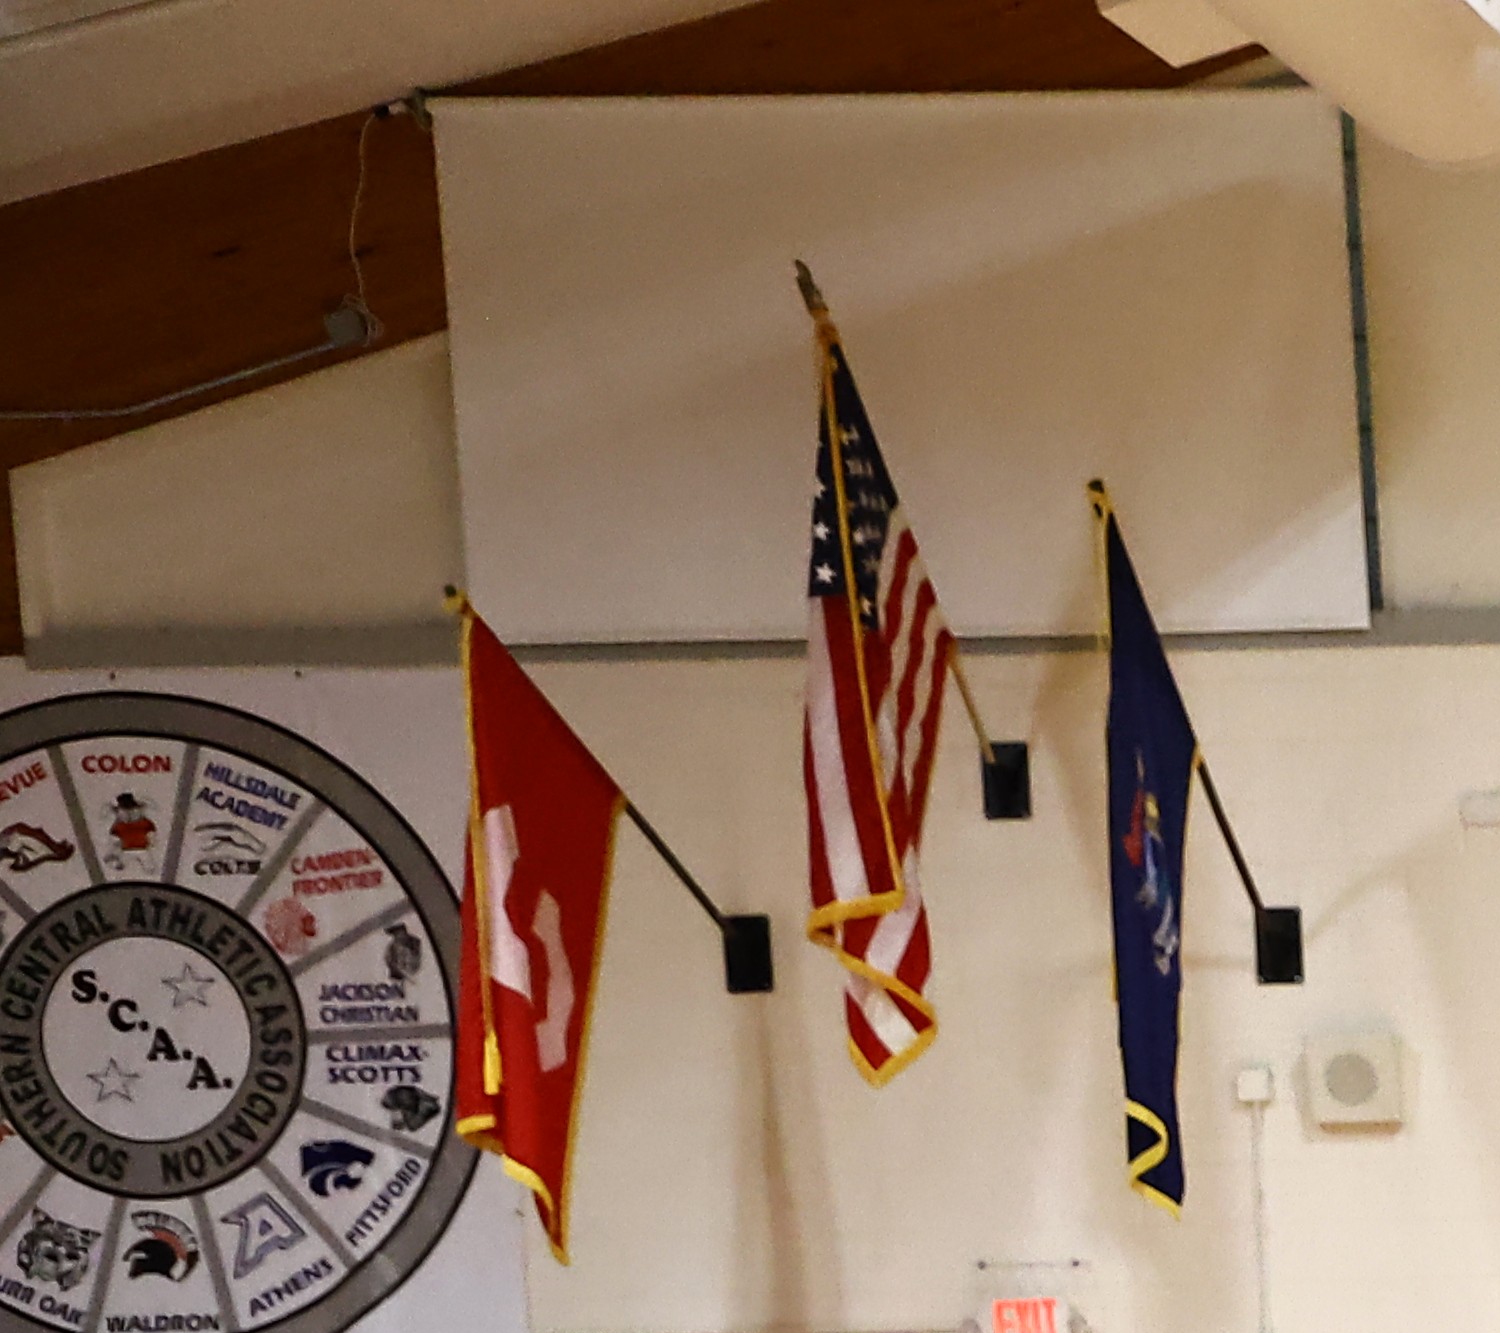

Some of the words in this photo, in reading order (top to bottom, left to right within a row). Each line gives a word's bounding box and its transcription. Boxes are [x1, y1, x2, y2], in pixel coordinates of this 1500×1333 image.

[80, 755, 172, 774] COLON
[204, 762, 301, 811] HILLSDALE
[196, 786, 289, 831] ACADEMY
[1, 903, 117, 1021] CENTRAL
[127, 896, 277, 998] ATHLETIC
[319, 984, 406, 1001] JACKSON
[319, 1005, 420, 1024] CHRISTIAN
[158, 1003, 293, 1185] ASSOCIATION
[328, 1067, 422, 1083] SCOTTS
[1, 1033, 130, 1182] SOUTHERN
[344, 1156, 423, 1248] PITTSFORD
[39, 1295, 84, 1325] OAK
[248, 1256, 334, 1318] ATHENS
[106, 1314, 220, 1333] WALDRON
